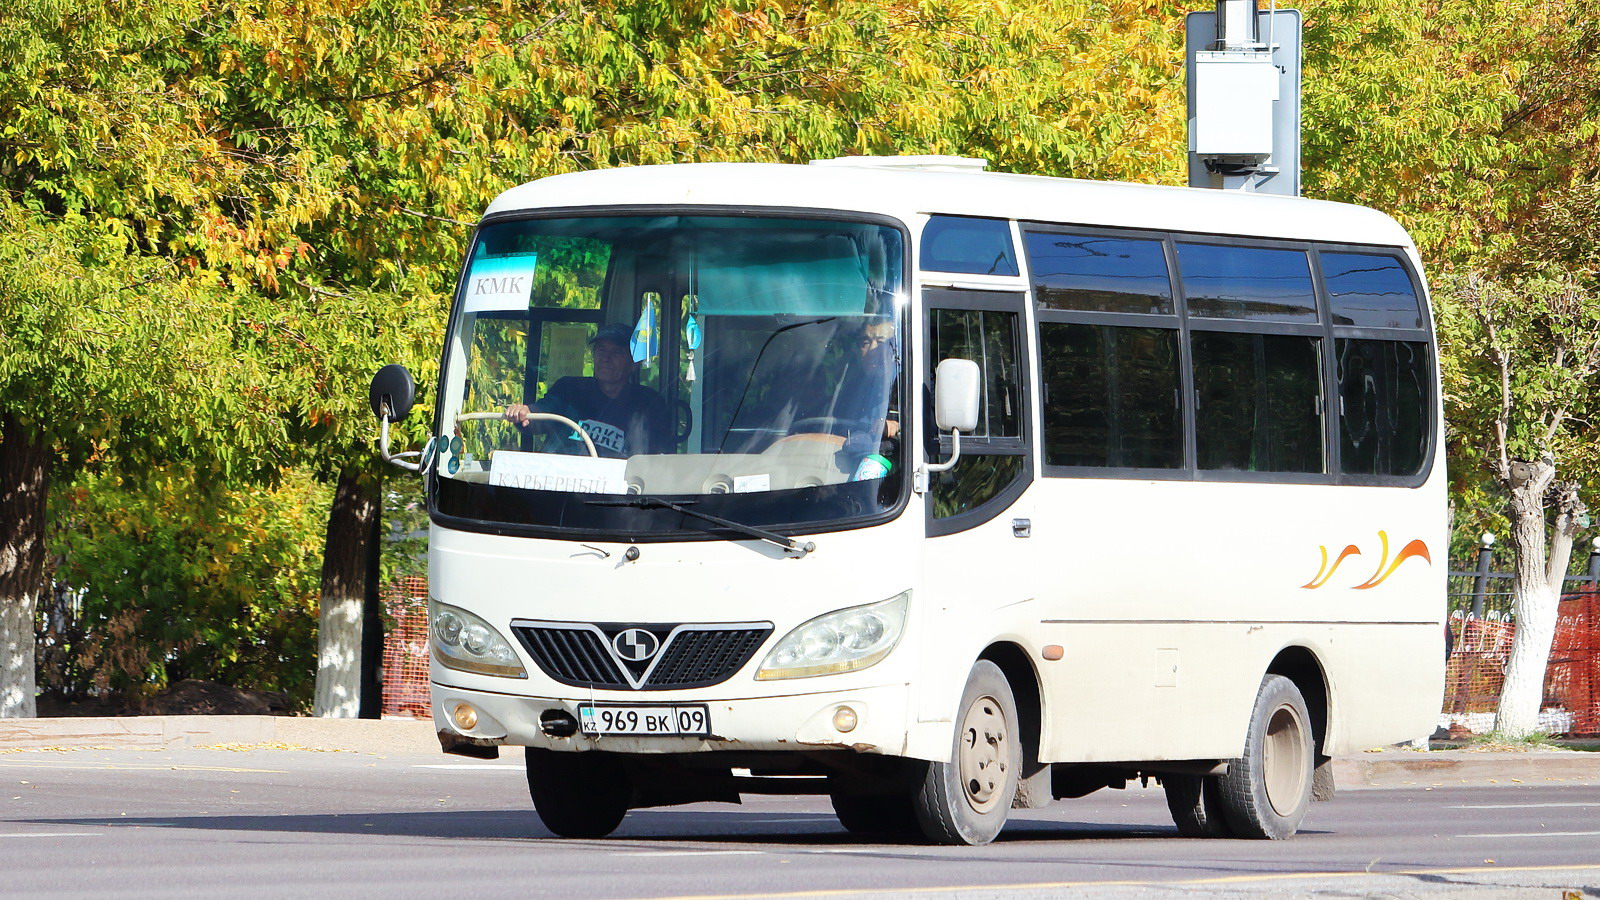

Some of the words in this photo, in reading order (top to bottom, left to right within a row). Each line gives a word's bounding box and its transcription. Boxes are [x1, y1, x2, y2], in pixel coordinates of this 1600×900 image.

[474, 276, 524, 296] КМК
[498, 472, 607, 494] КАРЬЕРНЫЙ
[583, 721, 598, 732] KZ
[601, 710, 639, 732] 969
[645, 715, 670, 732] BK
[679, 710, 704, 732] 09
